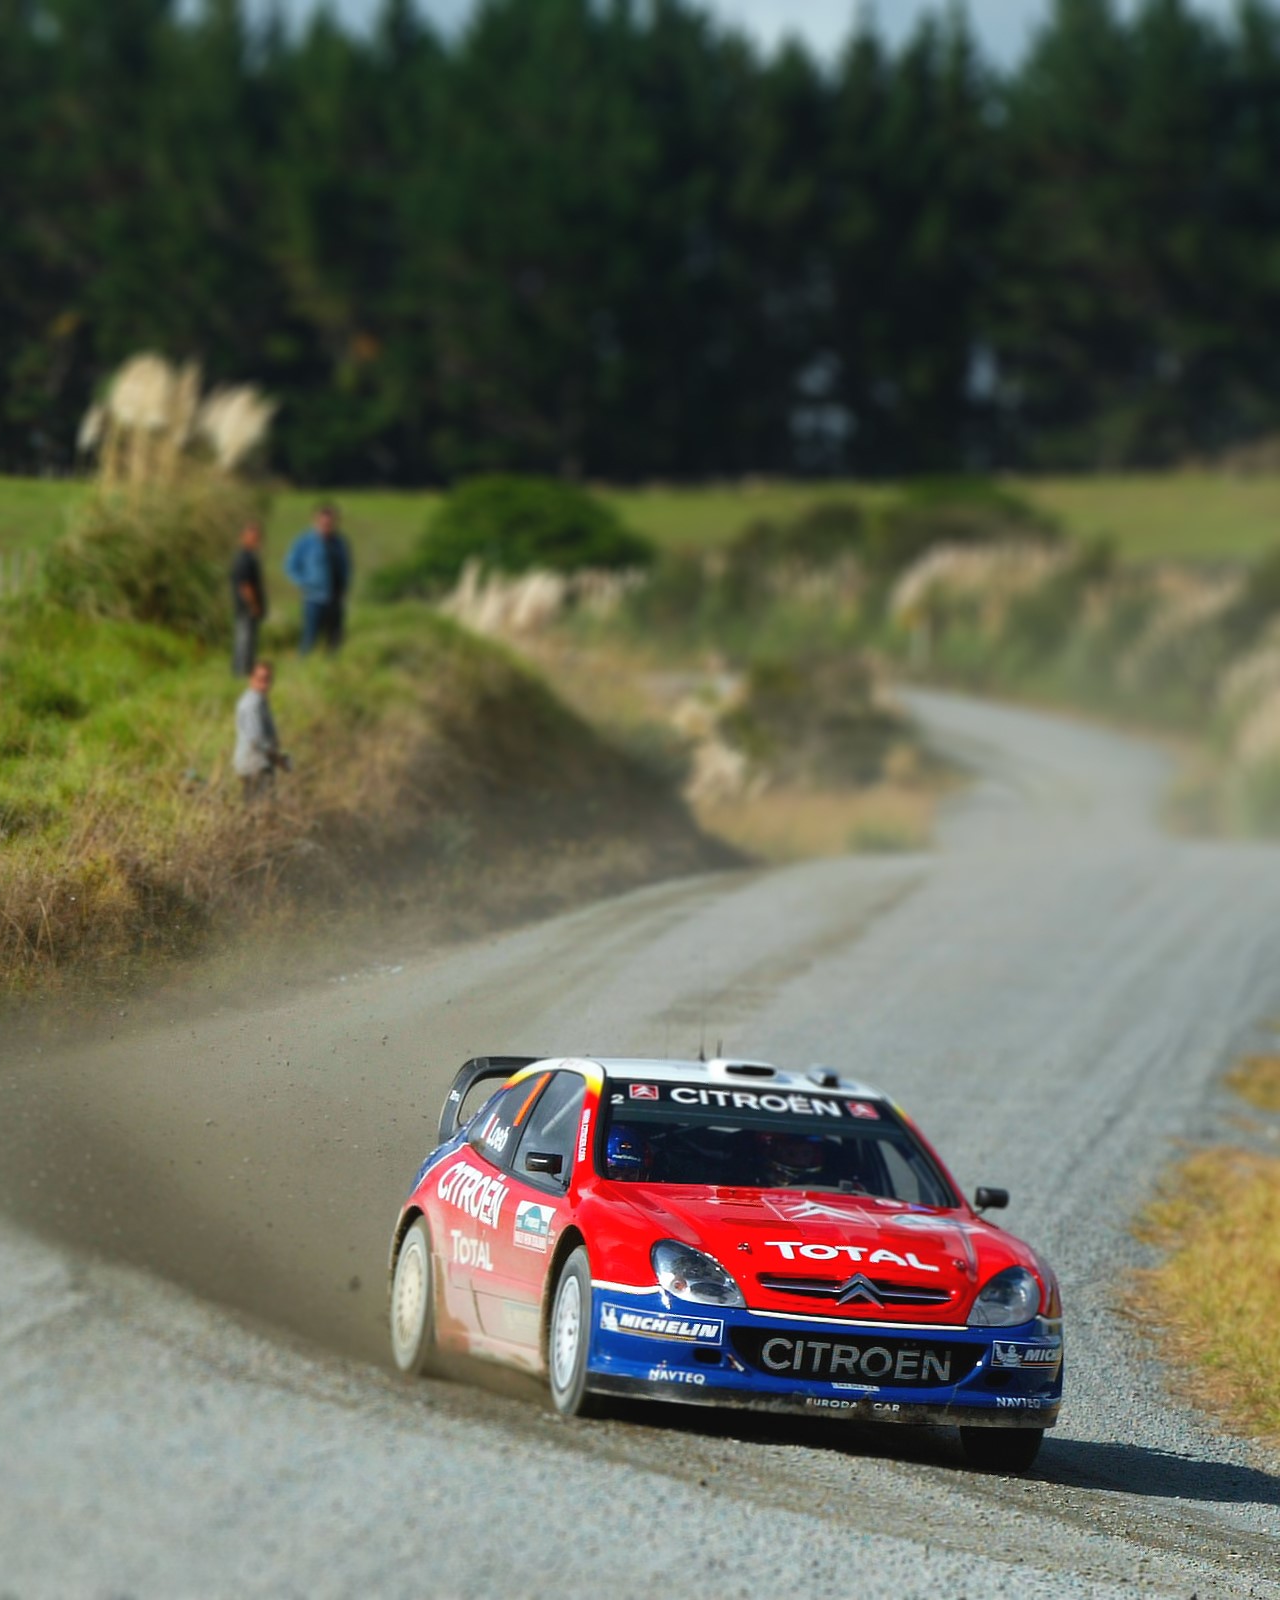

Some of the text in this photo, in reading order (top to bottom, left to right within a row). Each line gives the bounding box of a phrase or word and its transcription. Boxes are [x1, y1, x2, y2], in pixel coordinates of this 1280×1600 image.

[610, 1093, 625, 1104] 2
[670, 1086, 842, 1117] CITROËN
[486, 1117, 511, 1152] Loeb
[437, 1161, 510, 1230] CITROËN
[450, 1229, 494, 1272] TOTAL
[764, 1241, 940, 1272] TOTAL
[619, 1313, 719, 1338] MICHELIN
[761, 1337, 952, 1381] CITROËN
[648, 1369, 706, 1385] NAVTEQ
[996, 1397, 1041, 1408] NAVTEQ
